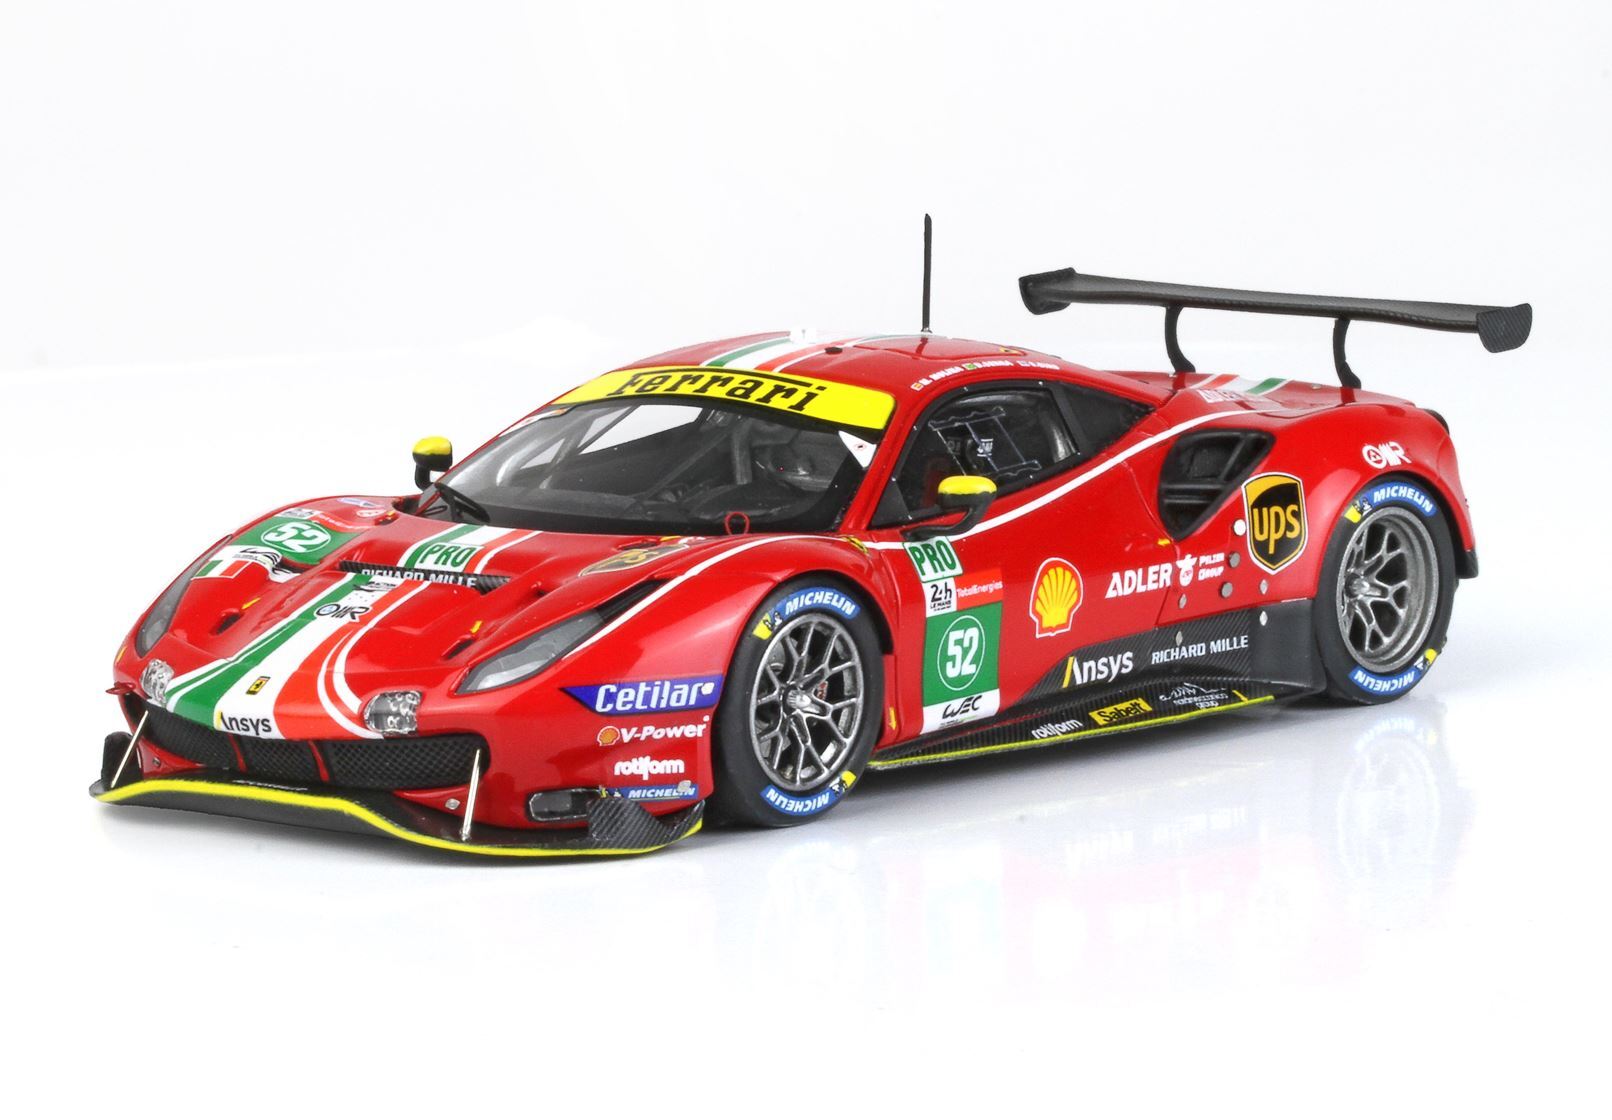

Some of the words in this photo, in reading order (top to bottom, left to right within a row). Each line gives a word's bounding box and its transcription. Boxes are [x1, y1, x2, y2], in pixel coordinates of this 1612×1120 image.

[606, 367, 827, 411] Ferrari
[1373, 485, 1434, 513] MICHELIN
[263, 521, 329, 553] 52
[1252, 504, 1301, 554] ups
[419, 543, 477, 568] PRO
[908, 540, 957, 576] PRO
[956, 580, 1003, 598] TotalEnergies
[1104, 562, 1173, 599] ADLER
[785, 591, 857, 616] MICHELIN
[945, 627, 980, 678] 52
[1151, 642, 1206, 665] RICHARD
[1209, 635, 1249, 655] MILLE
[1062, 651, 1134, 689] Ansys
[1354, 670, 1415, 692] MICHELIN
[596, 680, 707, 712] Cetilar
[942, 695, 983, 719] WEC
[215, 711, 272, 736] Ansys
[1098, 701, 1146, 724] Sabelt
[620, 724, 707, 743] V-Power
[1031, 718, 1083, 740] rotiform
[614, 756, 685, 780] rotiform
[766, 787, 830, 813] MICHELIN
